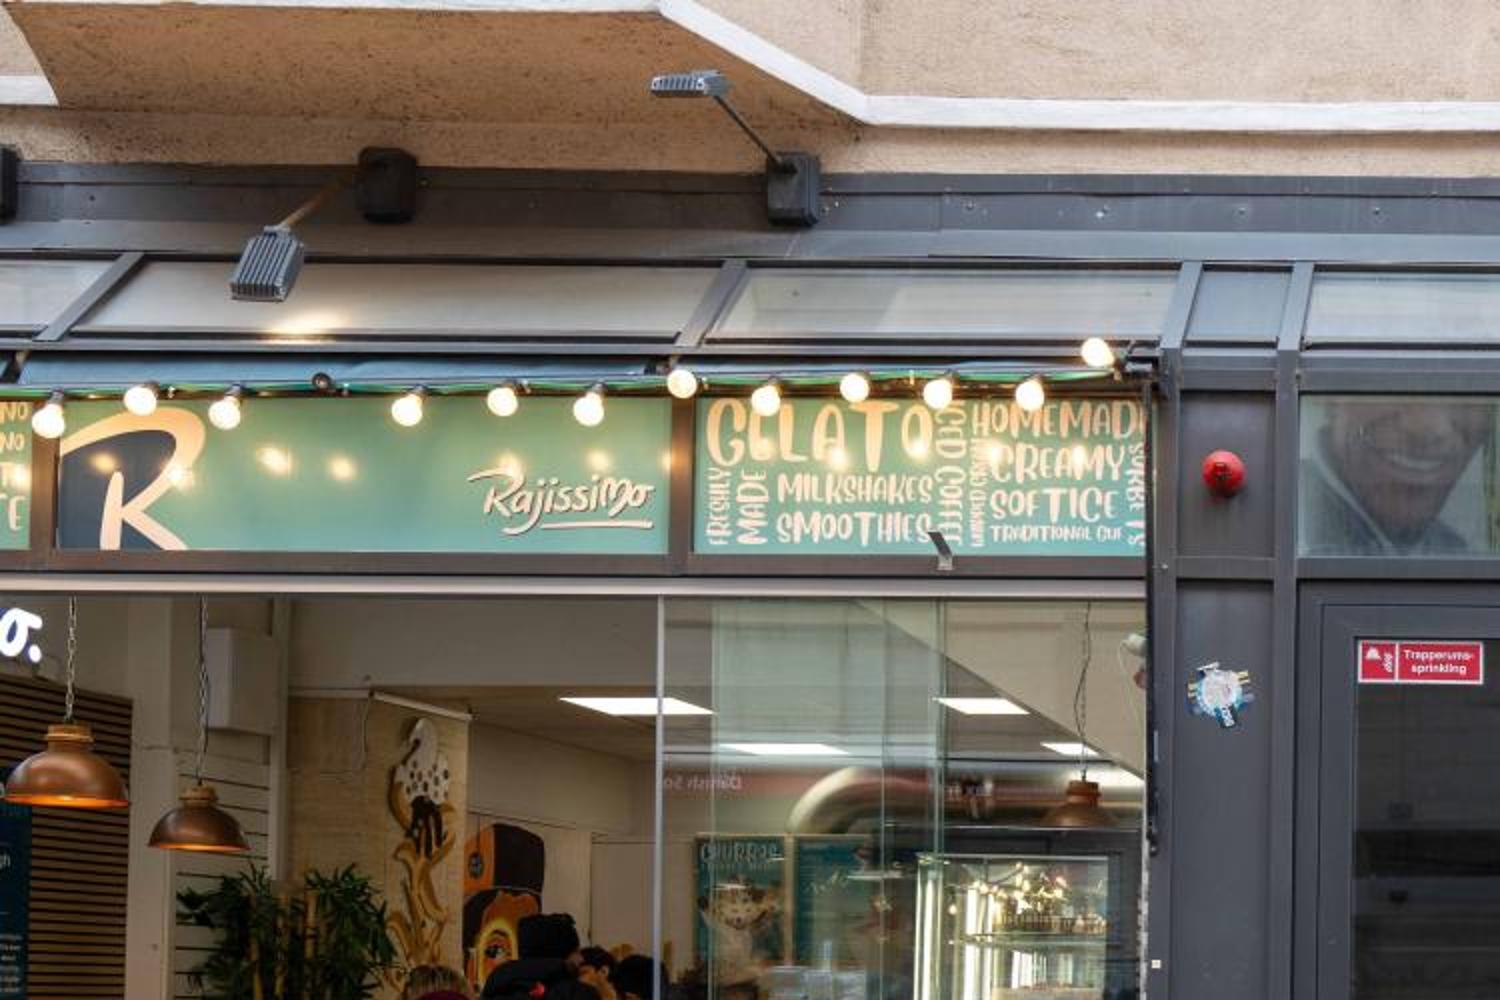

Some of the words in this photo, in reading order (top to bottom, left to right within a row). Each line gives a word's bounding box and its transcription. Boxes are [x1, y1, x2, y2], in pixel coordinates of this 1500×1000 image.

[706, 398, 932, 472] GELATO
[991, 442, 1124, 484] CREAMY
[467, 466, 655, 536] Rajissimo
[706, 467, 732, 545] FRESHLY
[735, 469, 769, 545] MADE
[777, 472, 932, 505] MILKSHAKES
[776, 511, 932, 547] SMOOTHIES
[989, 525, 1091, 543] TRADITIONAL
[1411, 663, 1467, 675] sprinkling
